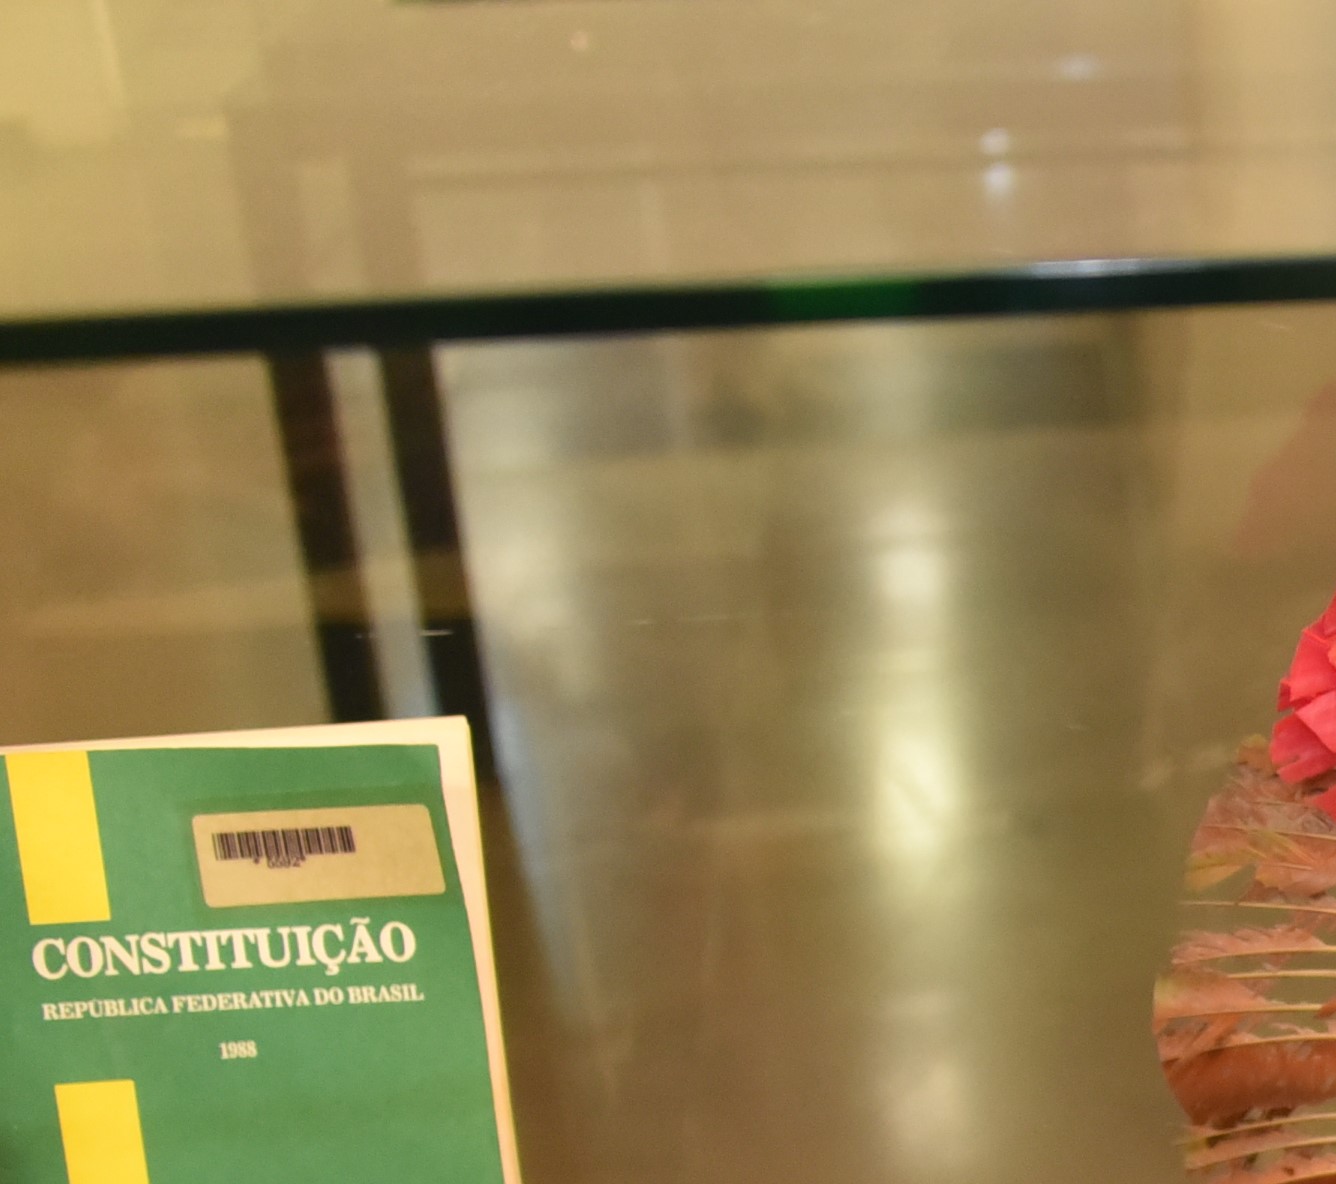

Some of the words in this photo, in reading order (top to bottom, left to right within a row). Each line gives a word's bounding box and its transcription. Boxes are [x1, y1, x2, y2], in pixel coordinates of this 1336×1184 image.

[32, 917, 416, 980] CONSTITUIÇÃO
[42, 994, 167, 1020] REPÚBLICA
[172, 990, 309, 1014] FEDERATIVA
[313, 988, 344, 1006] DO
[347, 984, 424, 1003] BRASIL
[219, 1041, 257, 1060] 1988
